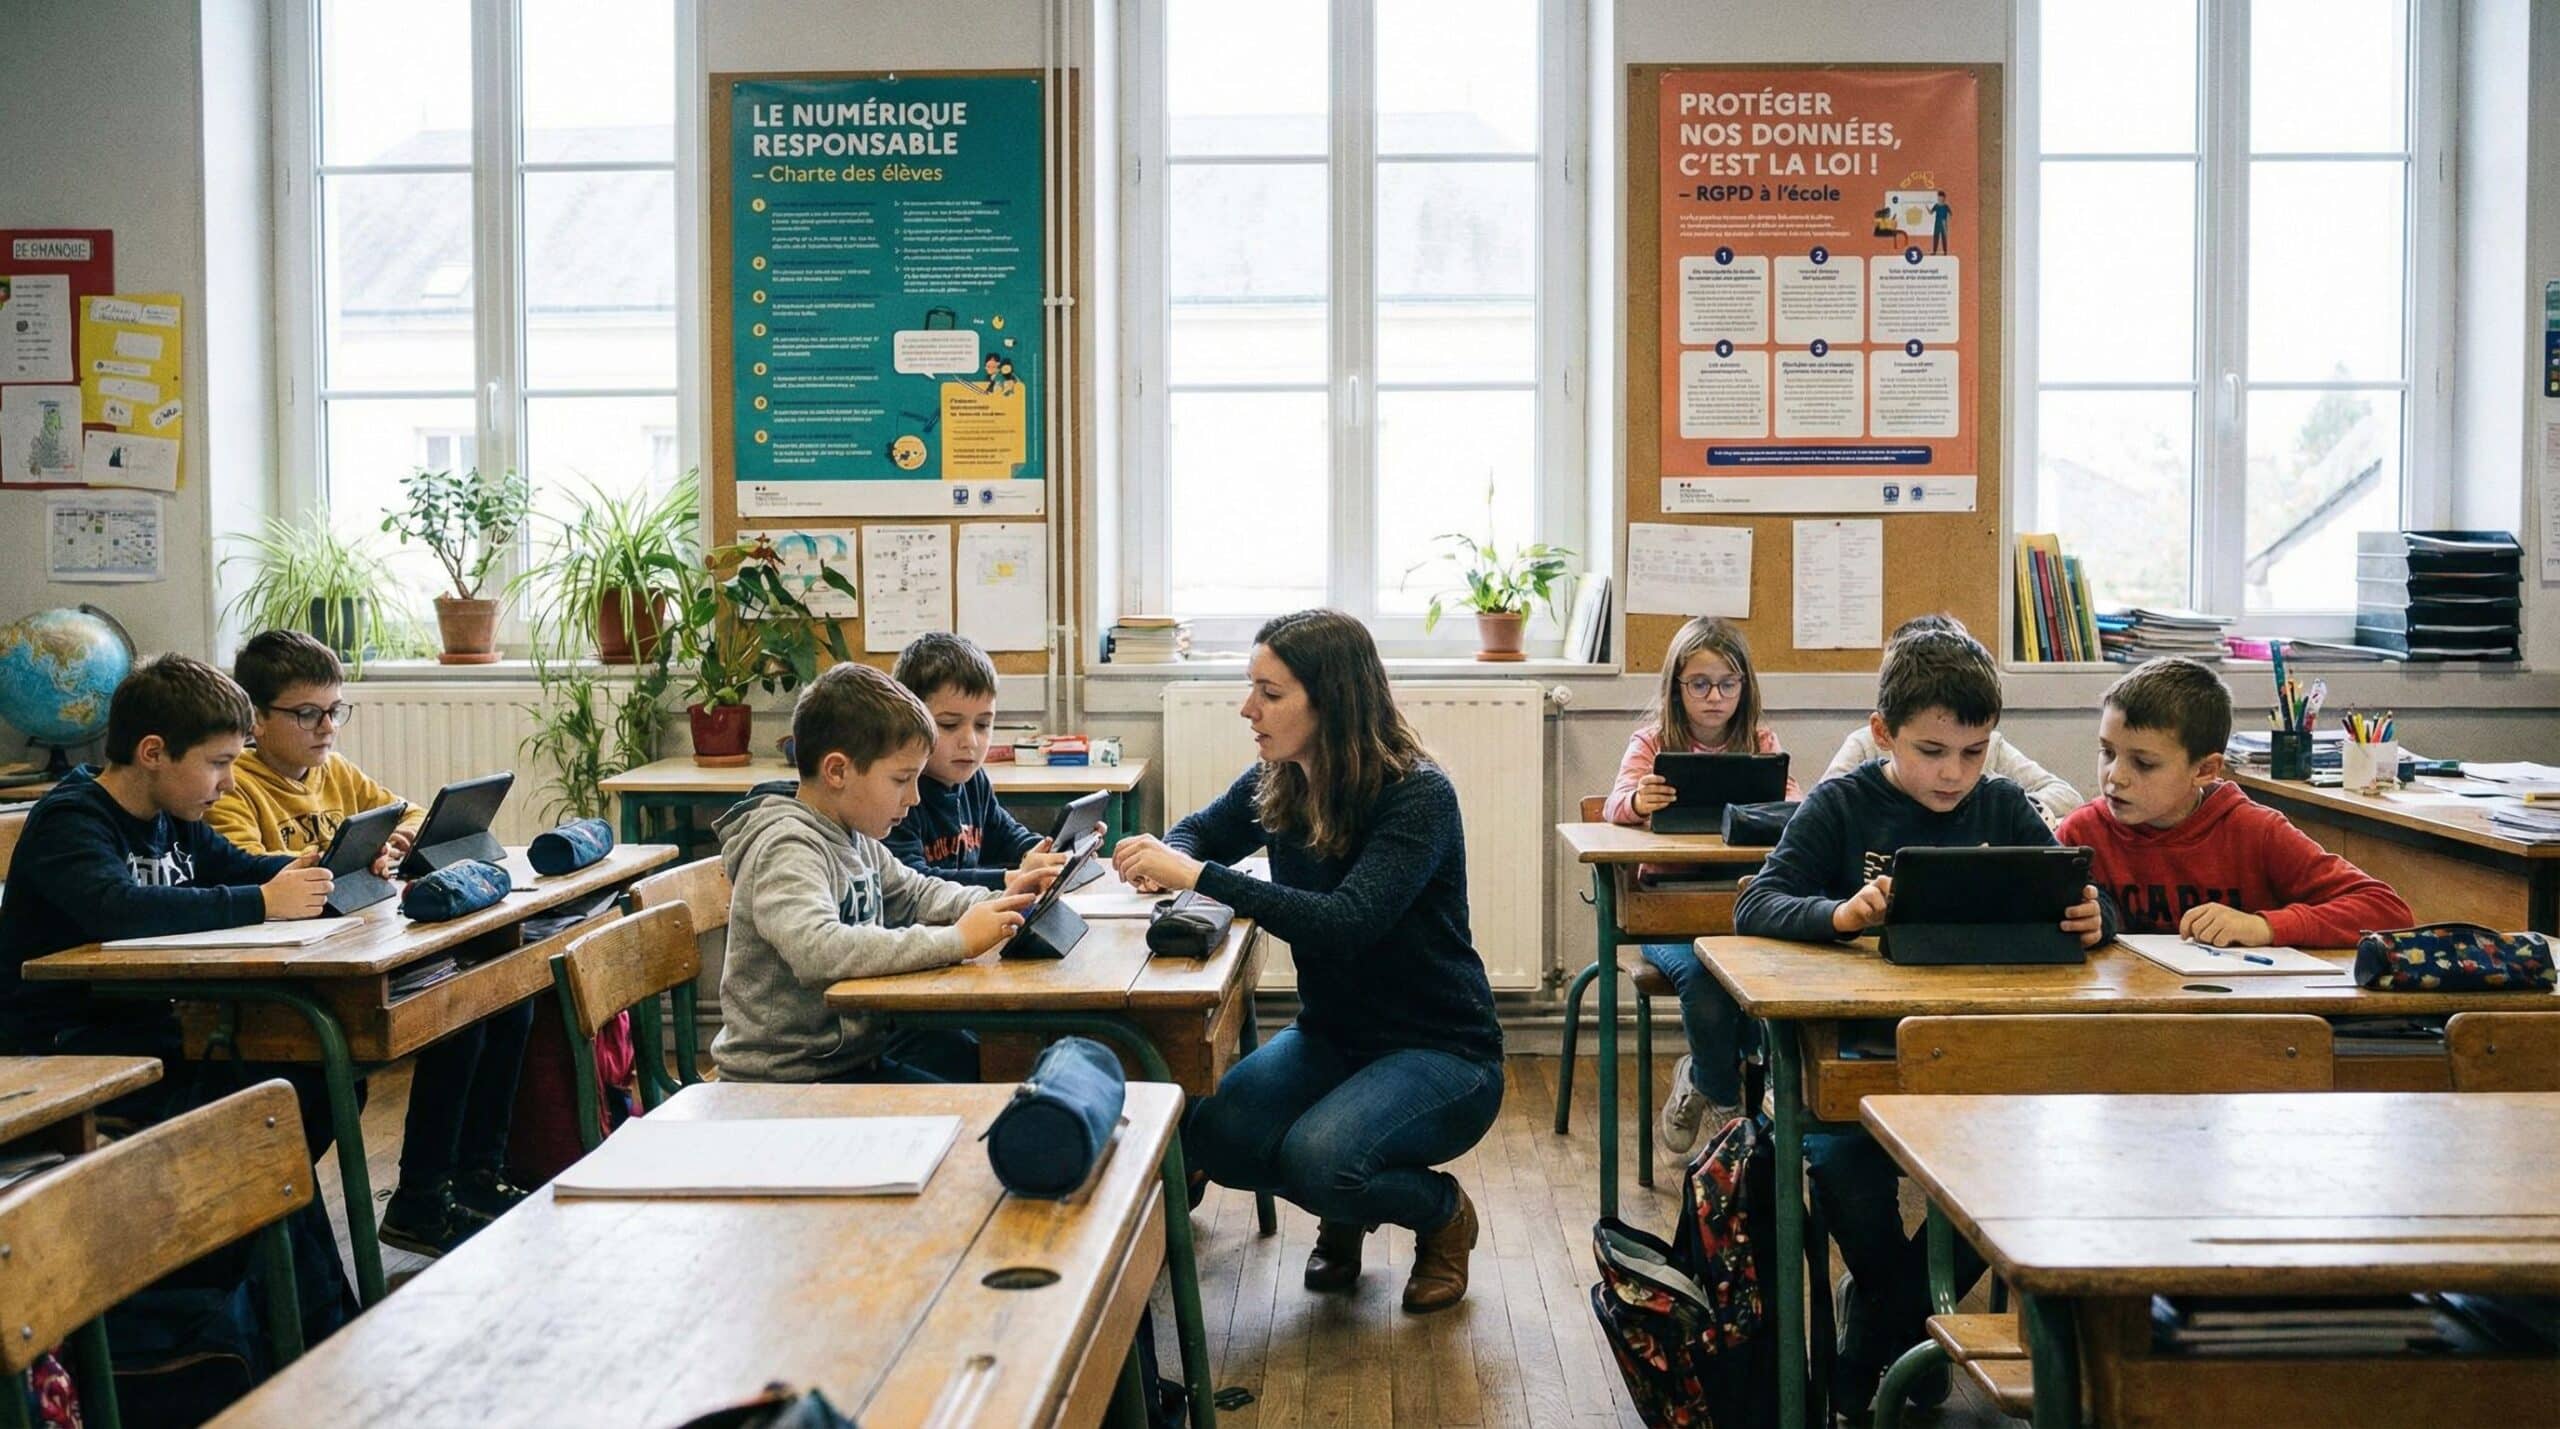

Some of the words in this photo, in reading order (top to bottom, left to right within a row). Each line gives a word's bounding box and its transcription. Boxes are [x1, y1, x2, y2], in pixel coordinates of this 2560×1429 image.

[753, 104, 784, 127] LE
[793, 97, 967, 130] NUMÉRIQUE
[1680, 88, 1833, 116] PROTÉGER
[753, 132, 958, 157] RESPONSABLE
[1680, 123, 1742, 146] NOS
[1752, 117, 1901, 149] DONNÉES,
[769, 165, 836, 182] Charte
[841, 164, 876, 182] des
[881, 164, 943, 182] élèves
[1769, 153, 1806, 176] LA
[1815, 153, 1860, 176] LOI
[1696, 185, 1753, 202] RGPD
[1760, 183, 1771, 202] à
